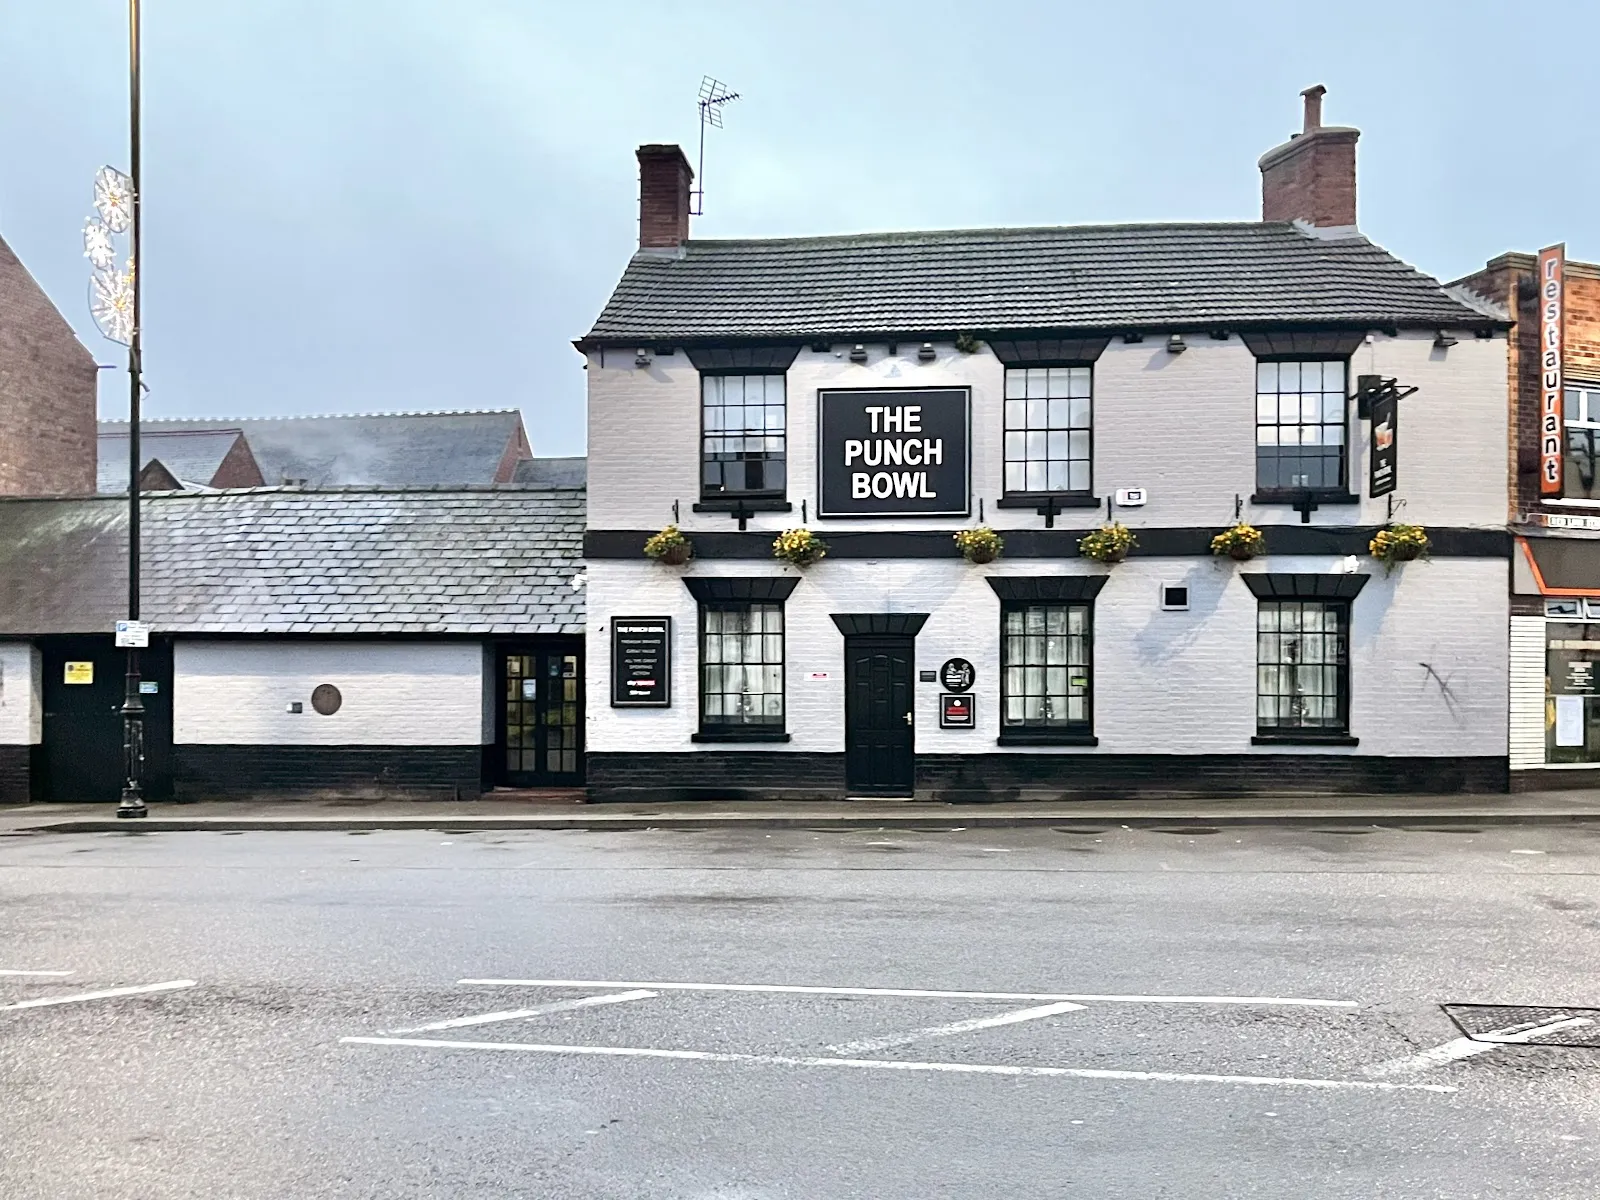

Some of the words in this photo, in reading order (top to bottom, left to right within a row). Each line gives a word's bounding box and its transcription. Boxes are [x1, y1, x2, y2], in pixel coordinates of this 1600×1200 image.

[1543, 259, 1559, 482] restaurant
[865, 405, 922, 433] THE
[844, 438, 943, 467] PUNCH
[852, 471, 937, 499] BOWL
